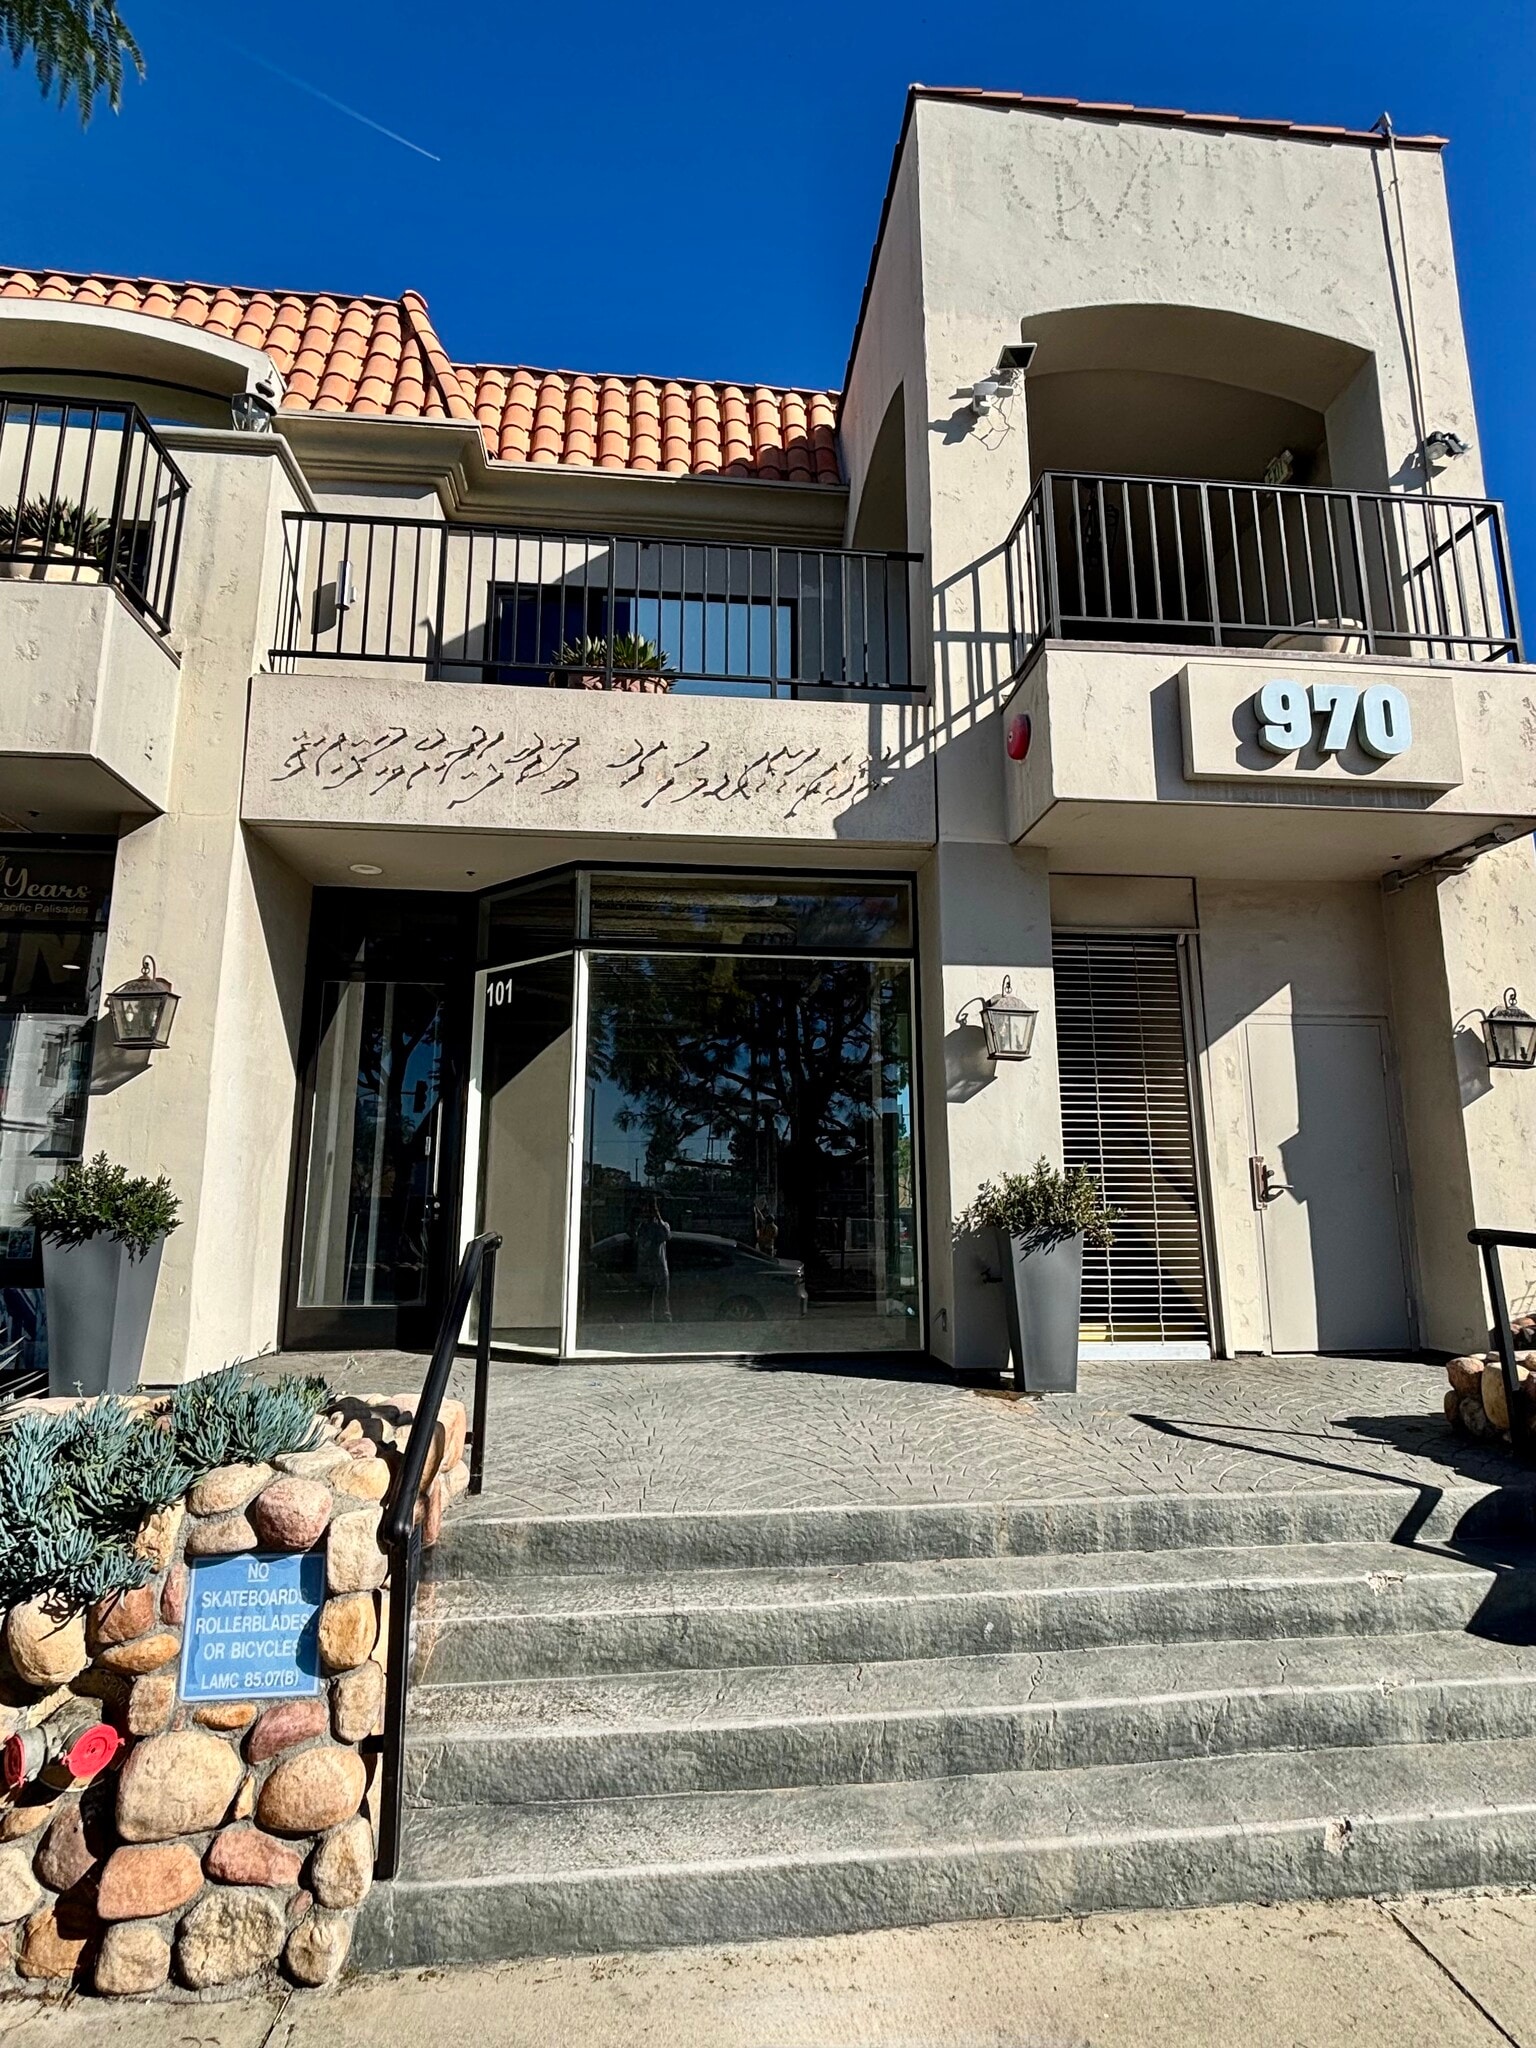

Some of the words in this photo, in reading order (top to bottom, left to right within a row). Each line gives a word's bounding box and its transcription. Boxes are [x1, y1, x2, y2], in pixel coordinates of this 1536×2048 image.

[1255, 679, 1413, 759] 970
[4, 867, 91, 899] Years
[34, 903, 89, 914] Palisades
[486, 978, 513, 1007] 101
[247, 1562, 270, 1580] NO
[203, 1642, 225, 1660] OR
[230, 1639, 301, 1659] BICYCLES
[201, 1672, 239, 1690] LAMC
[244, 1669, 299, 1687] 85.07(B)
